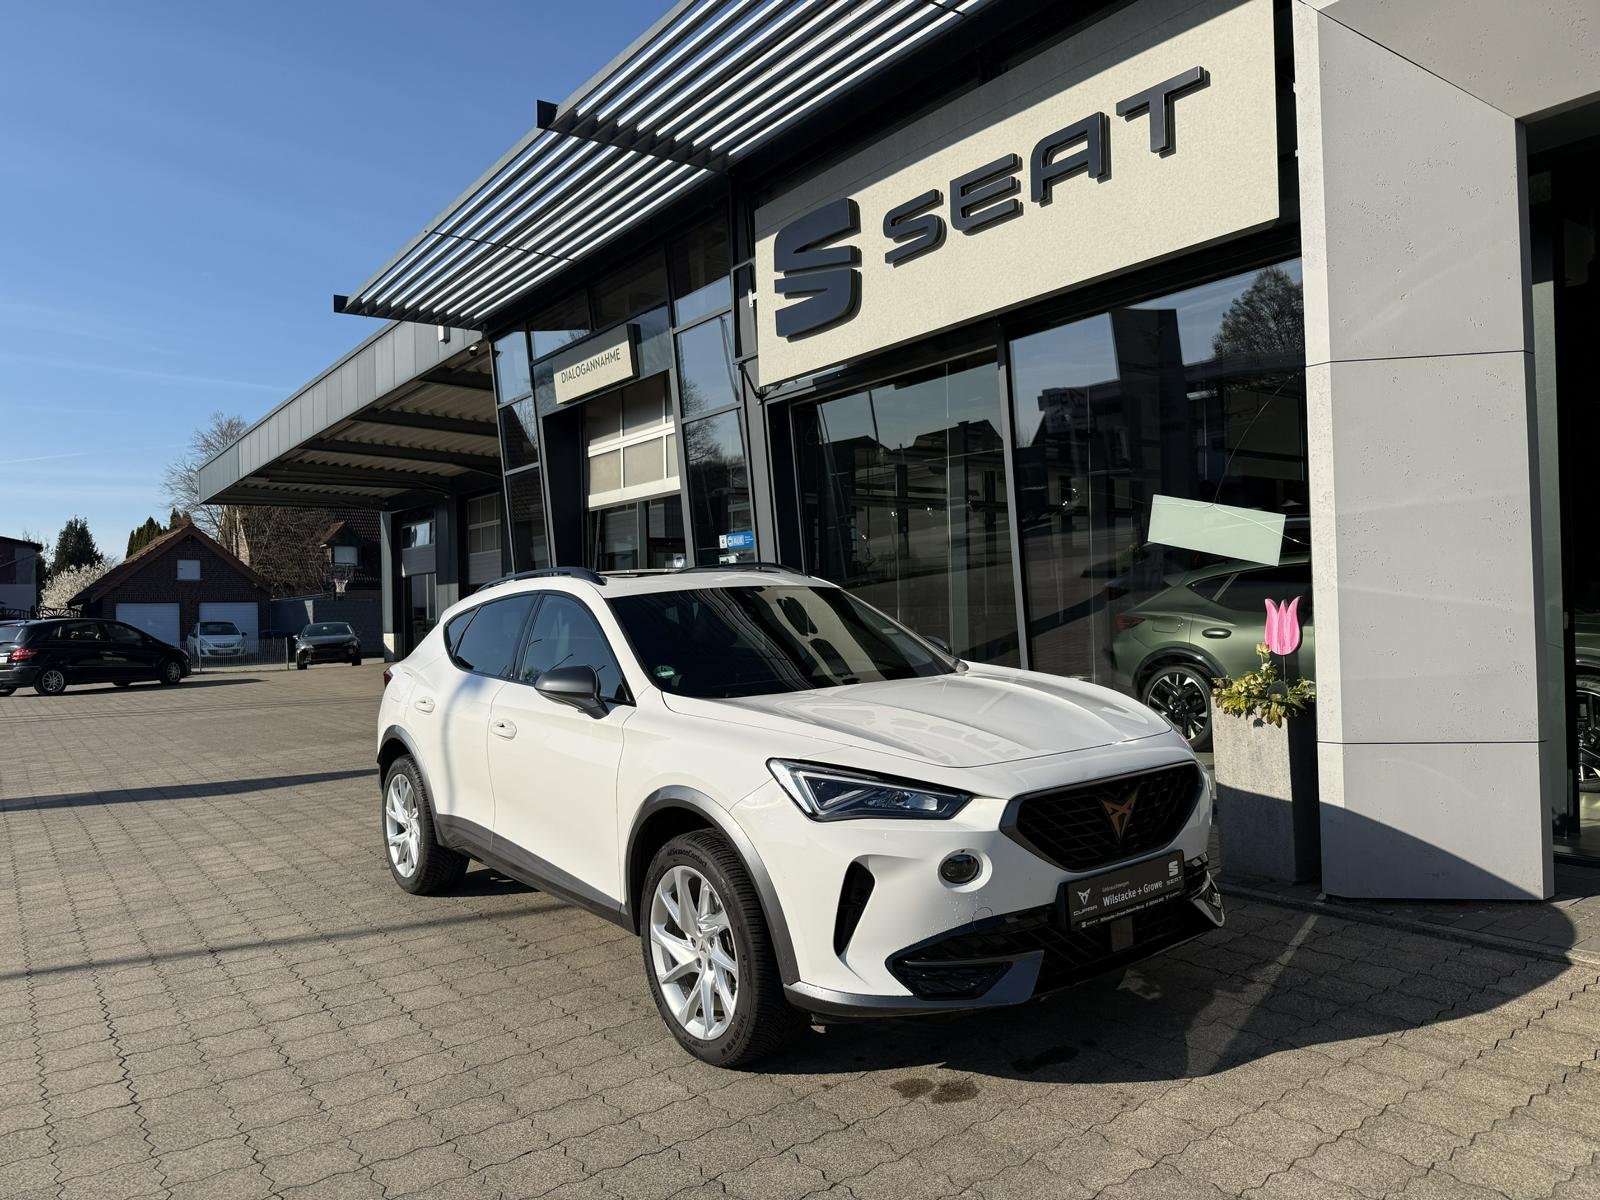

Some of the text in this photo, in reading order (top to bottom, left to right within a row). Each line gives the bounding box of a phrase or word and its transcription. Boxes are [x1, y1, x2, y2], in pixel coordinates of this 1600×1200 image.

[884, 66, 1209, 267] SEAT
[561, 348, 620, 383] DIALOGANNAHME
[1102, 888, 1136, 907] Wilstacke
[1143, 881, 1163, 893] Growe
